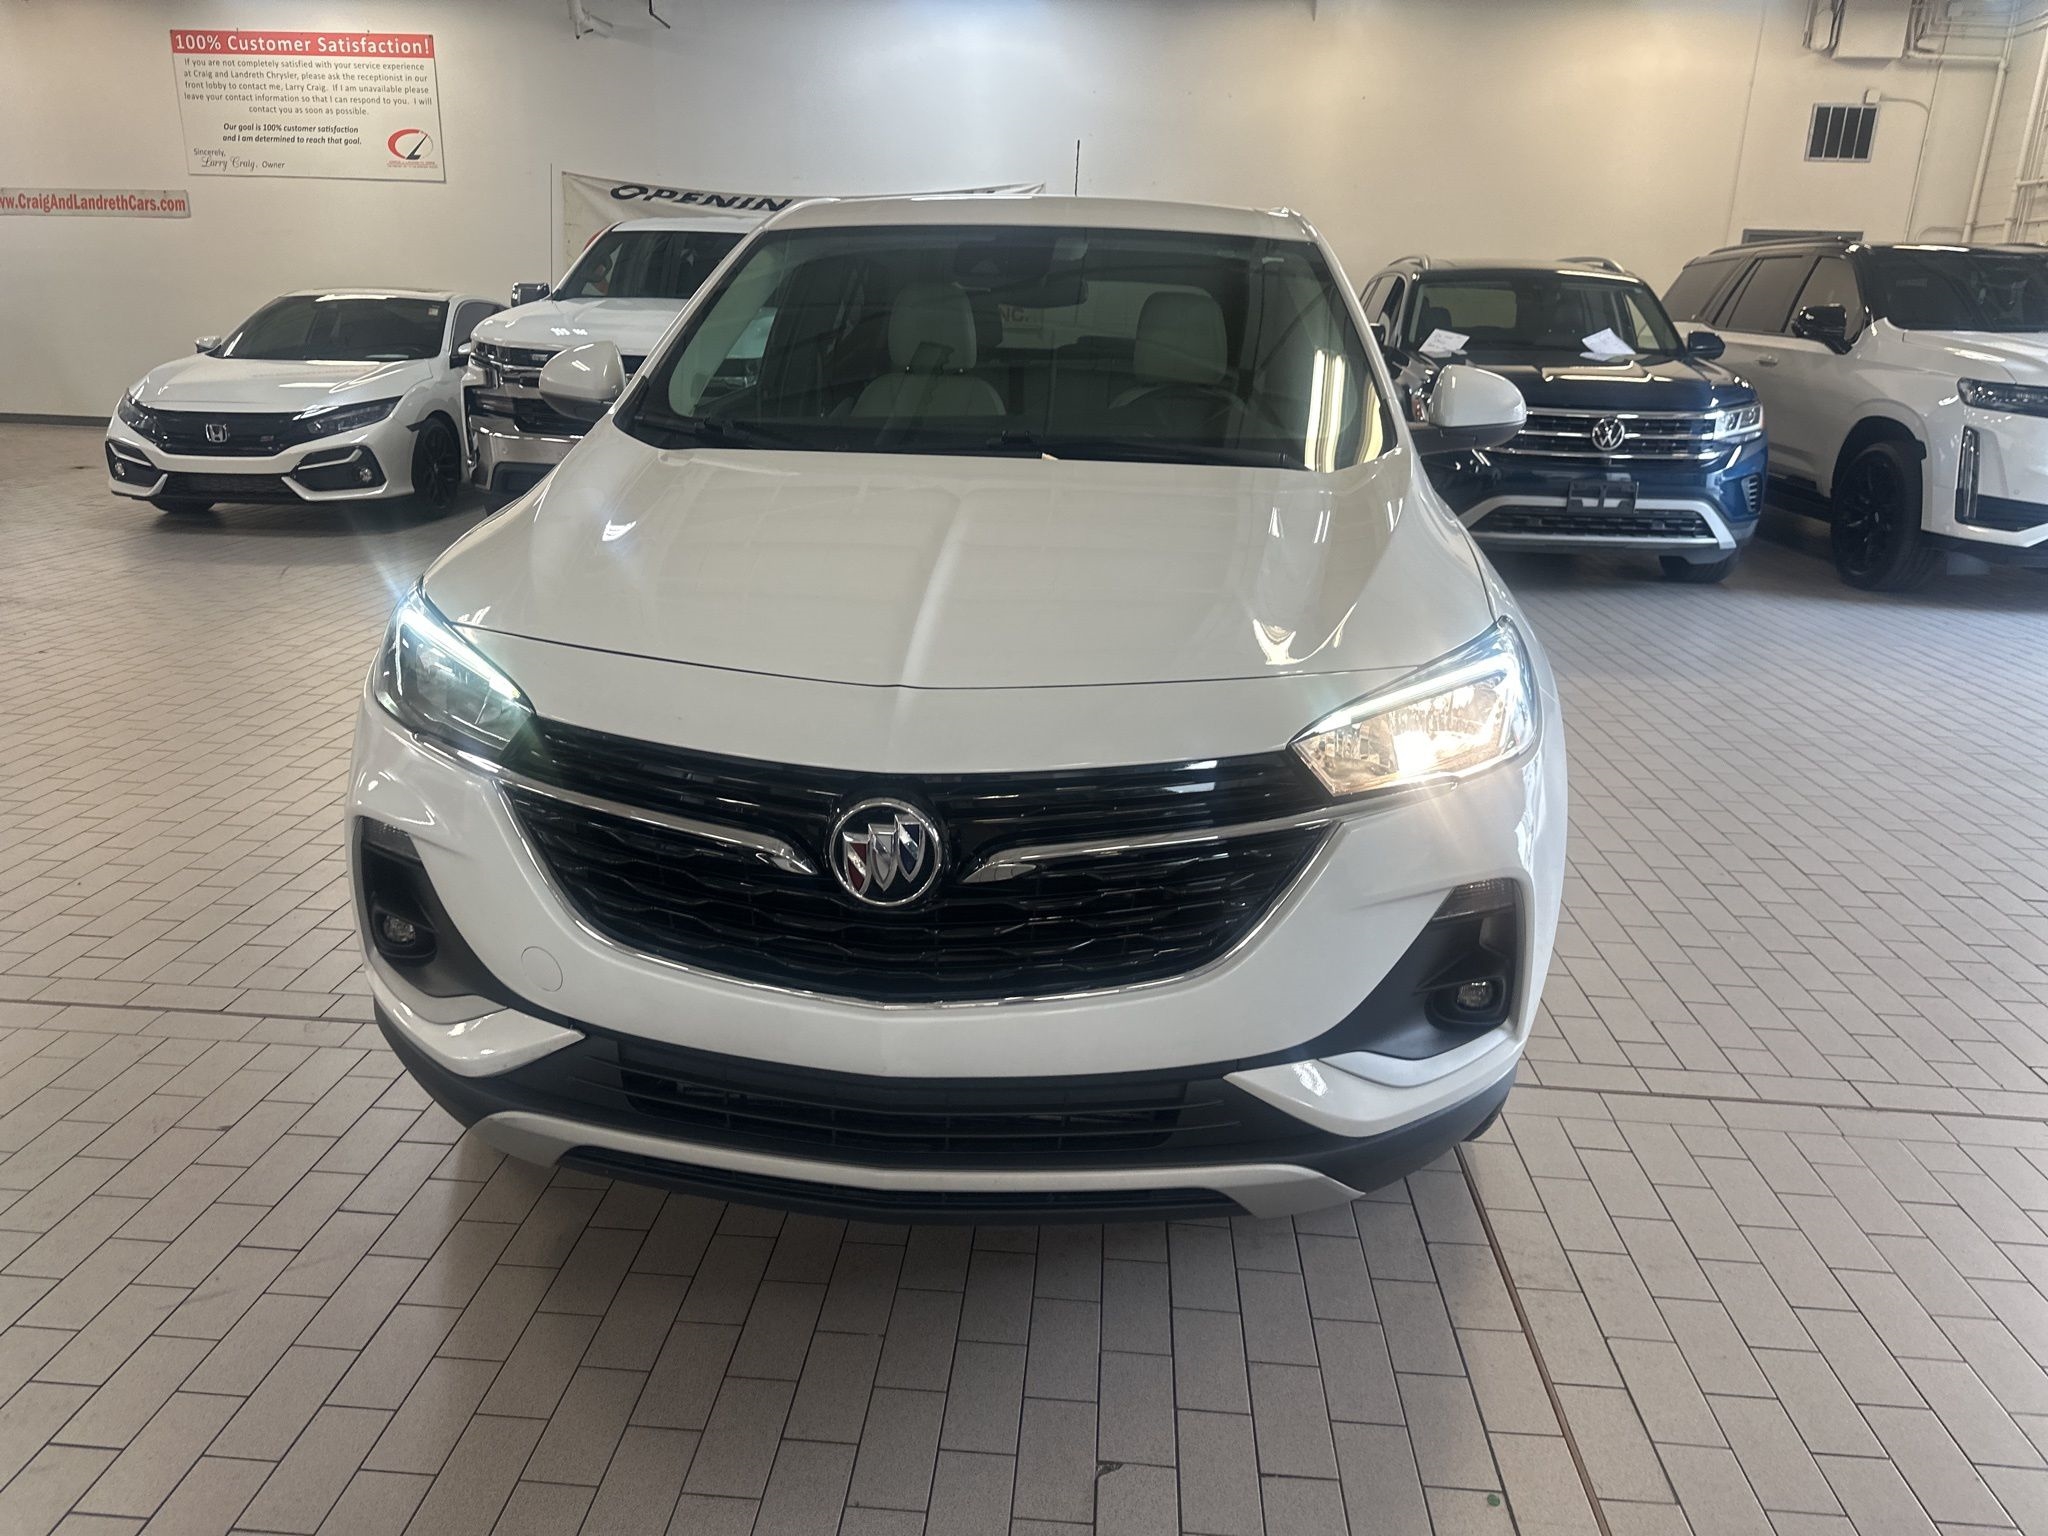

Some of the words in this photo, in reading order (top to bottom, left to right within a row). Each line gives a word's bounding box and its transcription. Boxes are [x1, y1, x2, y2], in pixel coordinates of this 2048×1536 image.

[175, 35, 221, 50] 100%
[227, 36, 311, 51] Customer
[317, 37, 429, 54] Satisfaction!
[237, 60, 278, 68] completely
[281, 60, 313, 68] satisfied
[193, 70, 213, 79] Craig
[215, 70, 229, 78] and
[230, 70, 265, 78] Landreth
[266, 71, 299, 80] Chrysler,
[301, 72, 326, 80] please
[357, 74, 403, 82] receptionist
[185, 81, 204, 89] front
[205, 82, 226, 90] lobby
[228, 82, 237, 90] to
[238, 82, 267, 90] contact
[285, 83, 304, 92] Larry
[306, 84, 329, 93] Craig.
[359, 84, 402, 93] unavailable
[404, 86, 429, 94] please
[184, 92, 204, 100] leave
[255, 93, 299, 102] information
[311, 95, 328, 103] that
[350, 96, 381, 105] respond
[394, 98, 410, 106] you.
[335, 107, 369, 115] possible.
[238, 123, 254, 132] goal
[255, 123, 261, 131] is
[318, 125, 358, 134] satisfaction
[222, 134, 236, 142] and
[255, 135, 295, 143] determined
[305, 136, 326, 144] reach
[327, 136, 342, 144] that
[344, 137, 361, 146] goal.
[193, 148, 226, 157] Sincerely,
[201, 156, 228, 172] Larry
[261, 160, 286, 169] Owner
